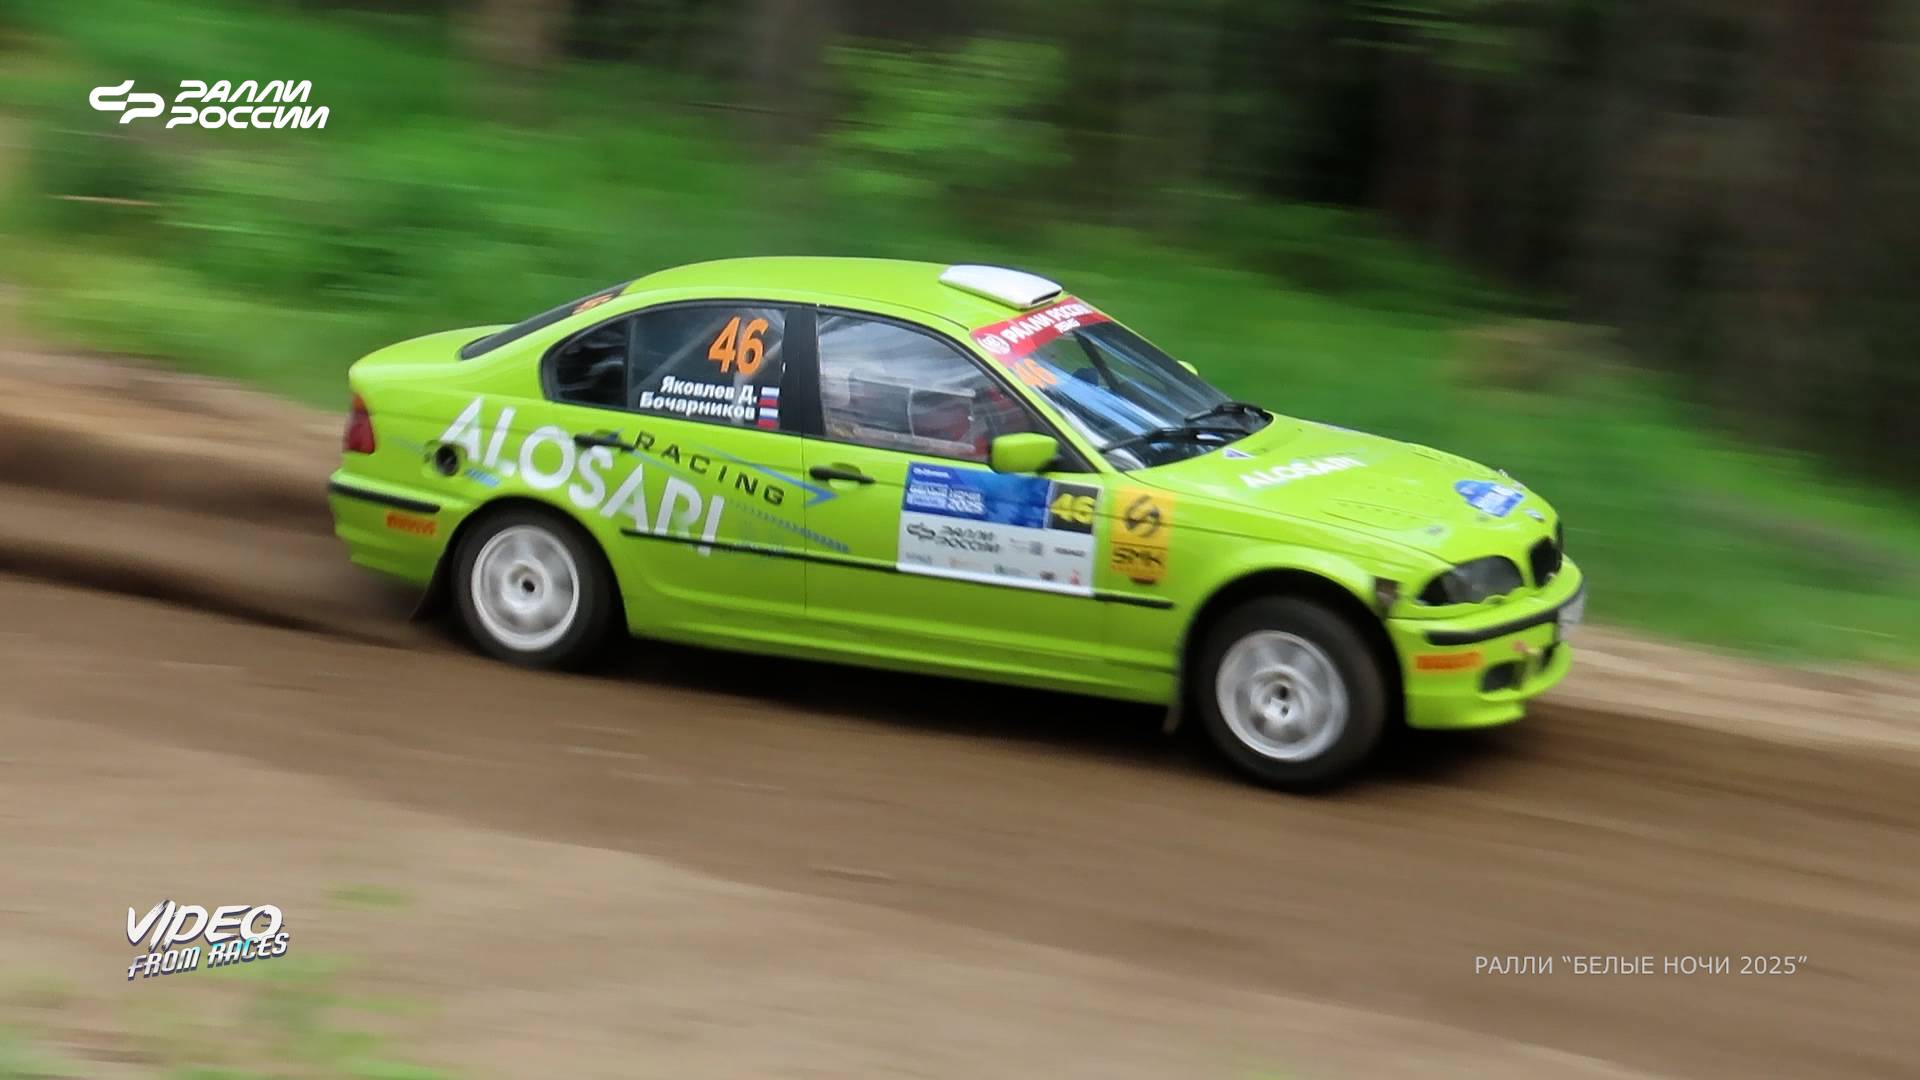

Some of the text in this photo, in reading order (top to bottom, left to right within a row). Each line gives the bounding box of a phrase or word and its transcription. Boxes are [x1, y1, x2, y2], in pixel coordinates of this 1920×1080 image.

[708, 315, 769, 377] 46
[639, 391, 756, 420] Бочарников
[660, 374, 758, 406] Яковлев Д.
[440, 396, 726, 556] ALOSARI
[633, 430, 786, 506] RACING
[1051, 493, 1096, 525] 46
